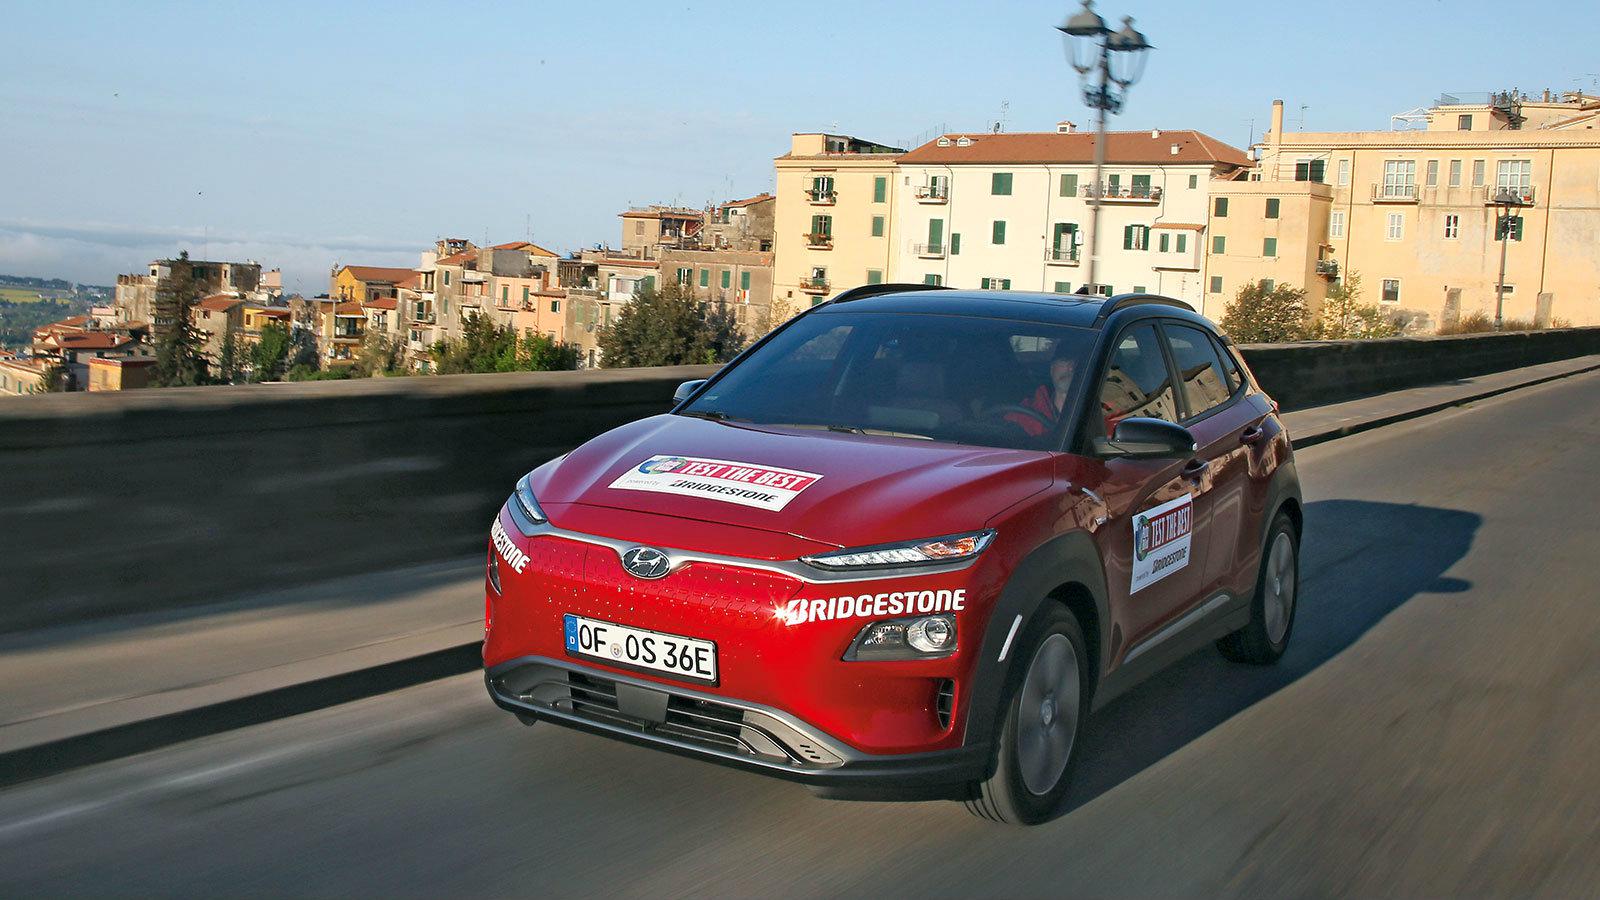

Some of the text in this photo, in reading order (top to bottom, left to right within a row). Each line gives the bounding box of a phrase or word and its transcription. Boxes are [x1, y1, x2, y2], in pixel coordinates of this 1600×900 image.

[669, 479, 778, 503] BRIDGESTONE
[680, 462, 721, 478] TEST
[720, 466, 758, 482] THE
[756, 470, 808, 489] BEST
[1152, 517, 1166, 548] TEST
[1166, 512, 1178, 541] THE
[1177, 506, 1190, 537] BEST
[784, 589, 966, 626] BRIDGESTONE
[569, 635, 576, 645] D
[579, 624, 711, 676] OF OS 36E
